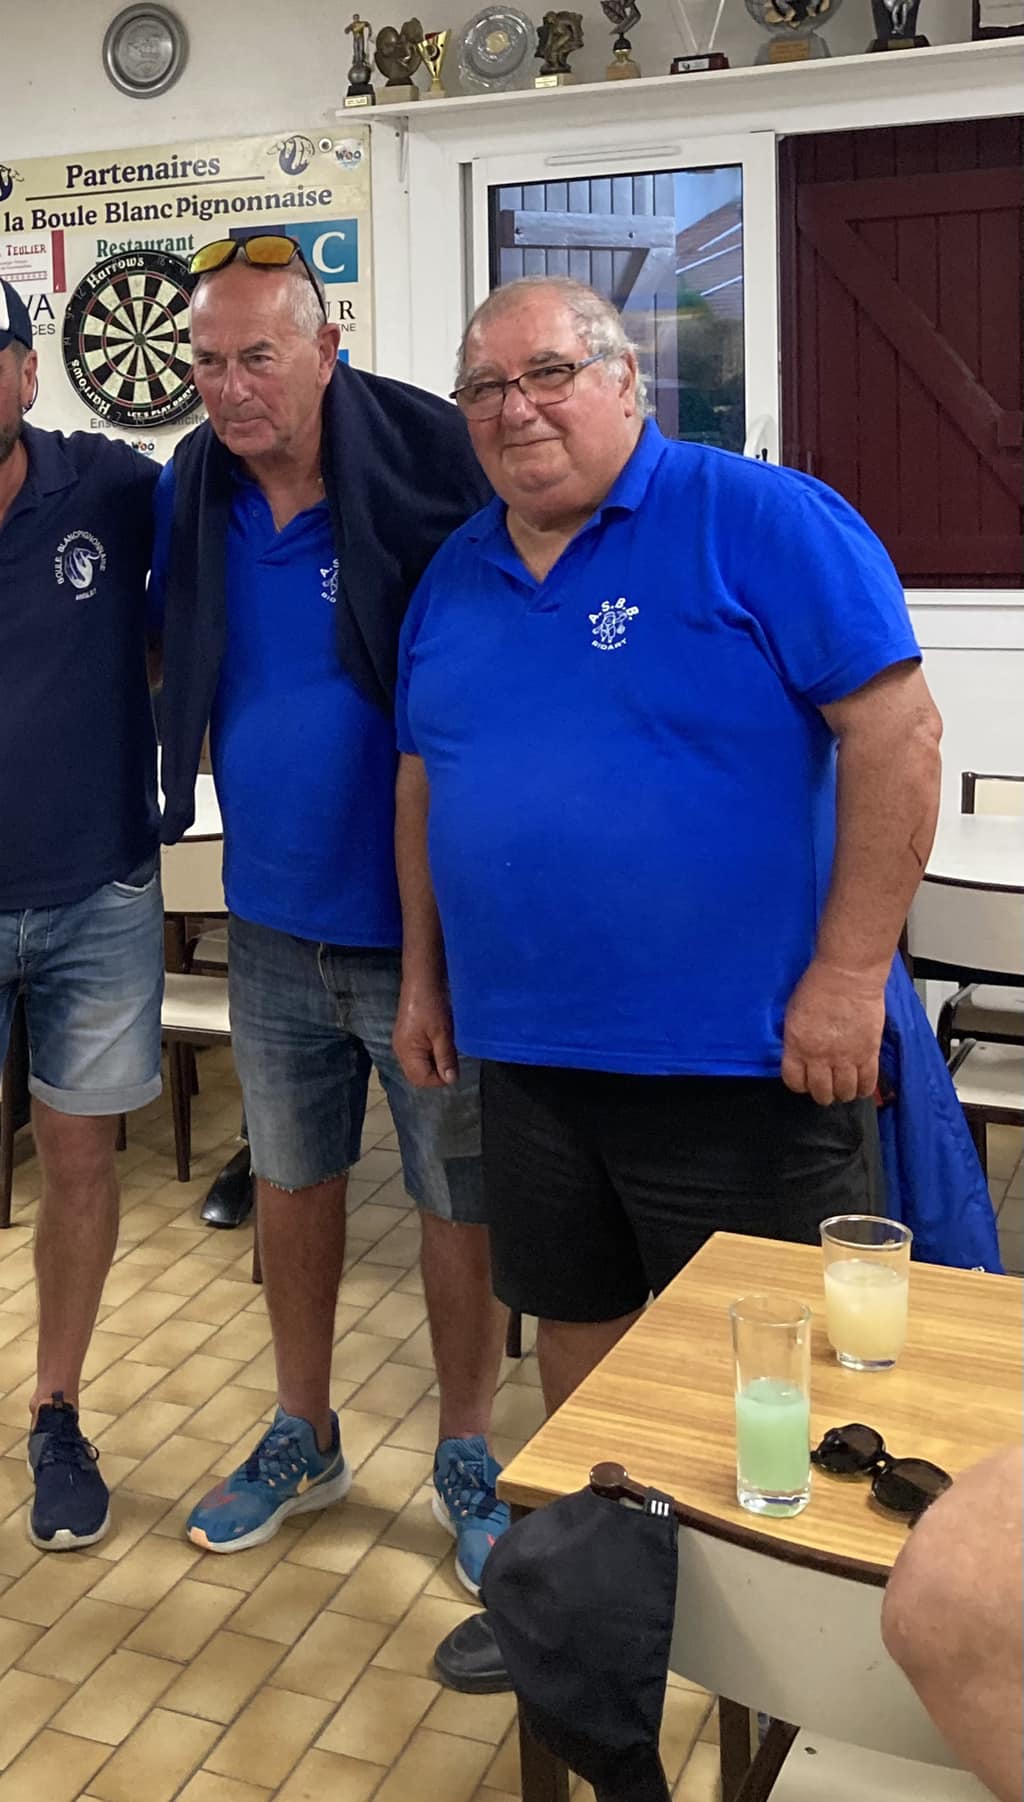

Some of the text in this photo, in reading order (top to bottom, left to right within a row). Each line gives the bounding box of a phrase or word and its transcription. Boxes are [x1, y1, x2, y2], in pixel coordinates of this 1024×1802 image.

[66, 154, 220, 189] Partenaires
[4, 211, 25, 232] la
[31, 205, 98, 230] Boule
[6, 244, 47, 257] TEULIER
[96, 233, 194, 257] Restaurant
[86, 256, 145, 288] Harrows
[71, 359, 111, 416] Harrows
